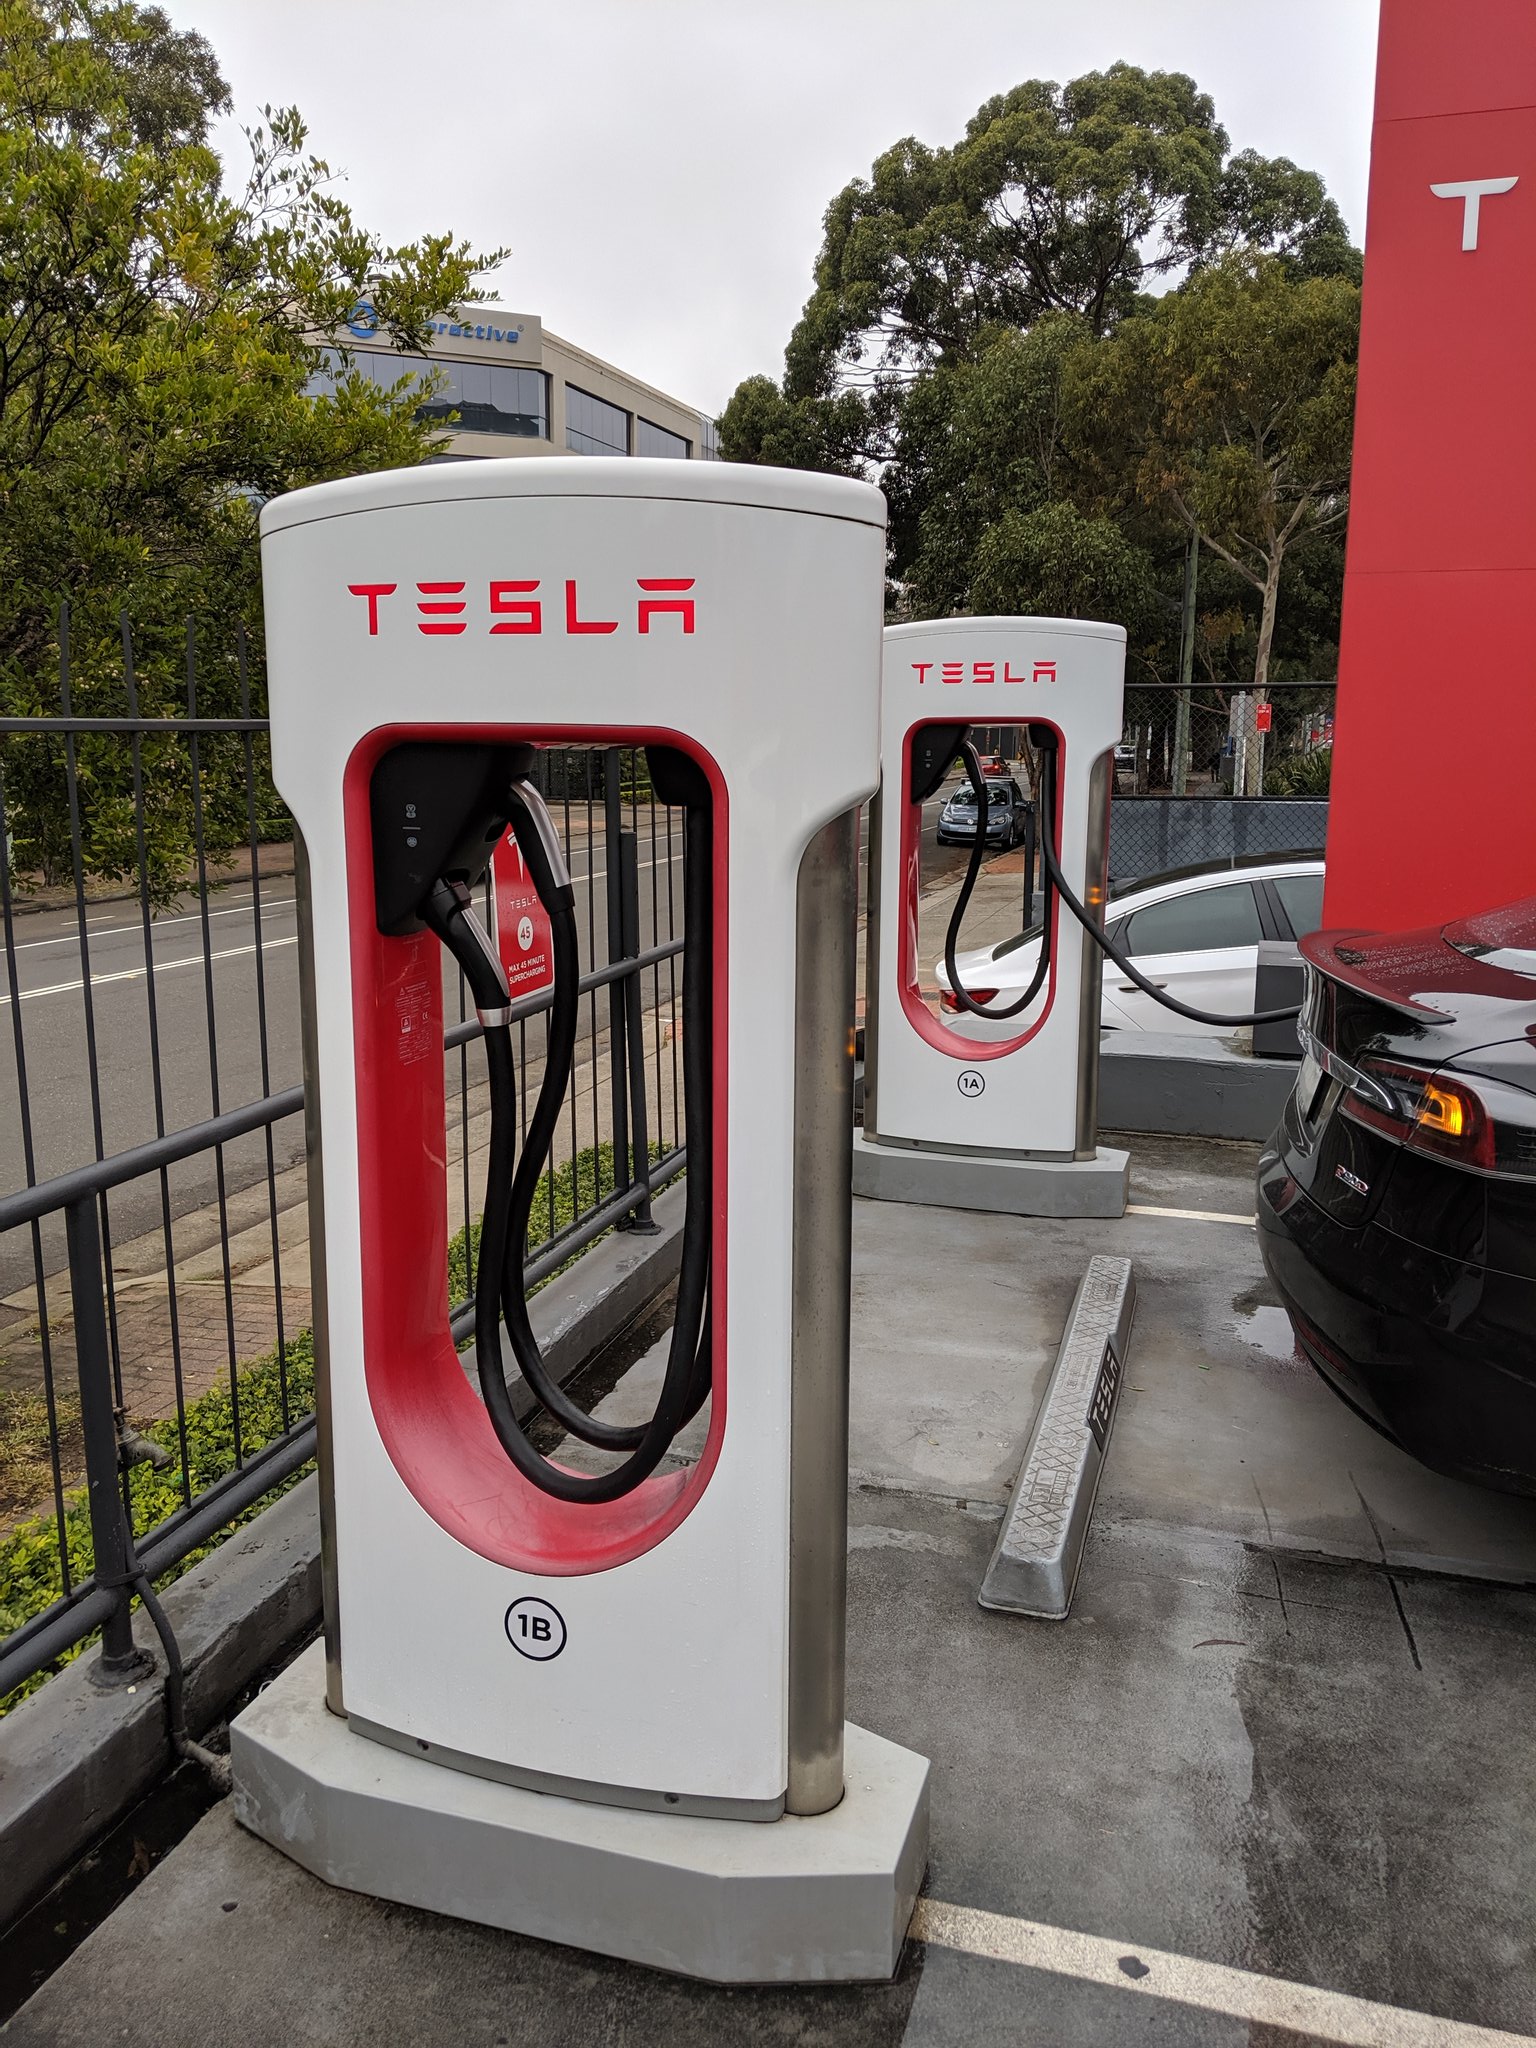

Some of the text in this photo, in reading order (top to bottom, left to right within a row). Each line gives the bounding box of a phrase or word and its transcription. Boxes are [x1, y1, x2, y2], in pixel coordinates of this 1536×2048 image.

[1429, 176, 1520, 252] T
[347, 579, 695, 635] TESLA
[911, 661, 1057, 684] TESLA
[510, 895, 537, 909] TESLA
[520, 926, 531, 940] 45
[509, 954, 545, 974] MAX 45 MINUTE
[509, 965, 546, 984] SUPERCHARGING
[963, 1077, 980, 1089] 1A
[1092, 1349, 1118, 1434] TESLA
[518, 1613, 552, 1642] 1B
